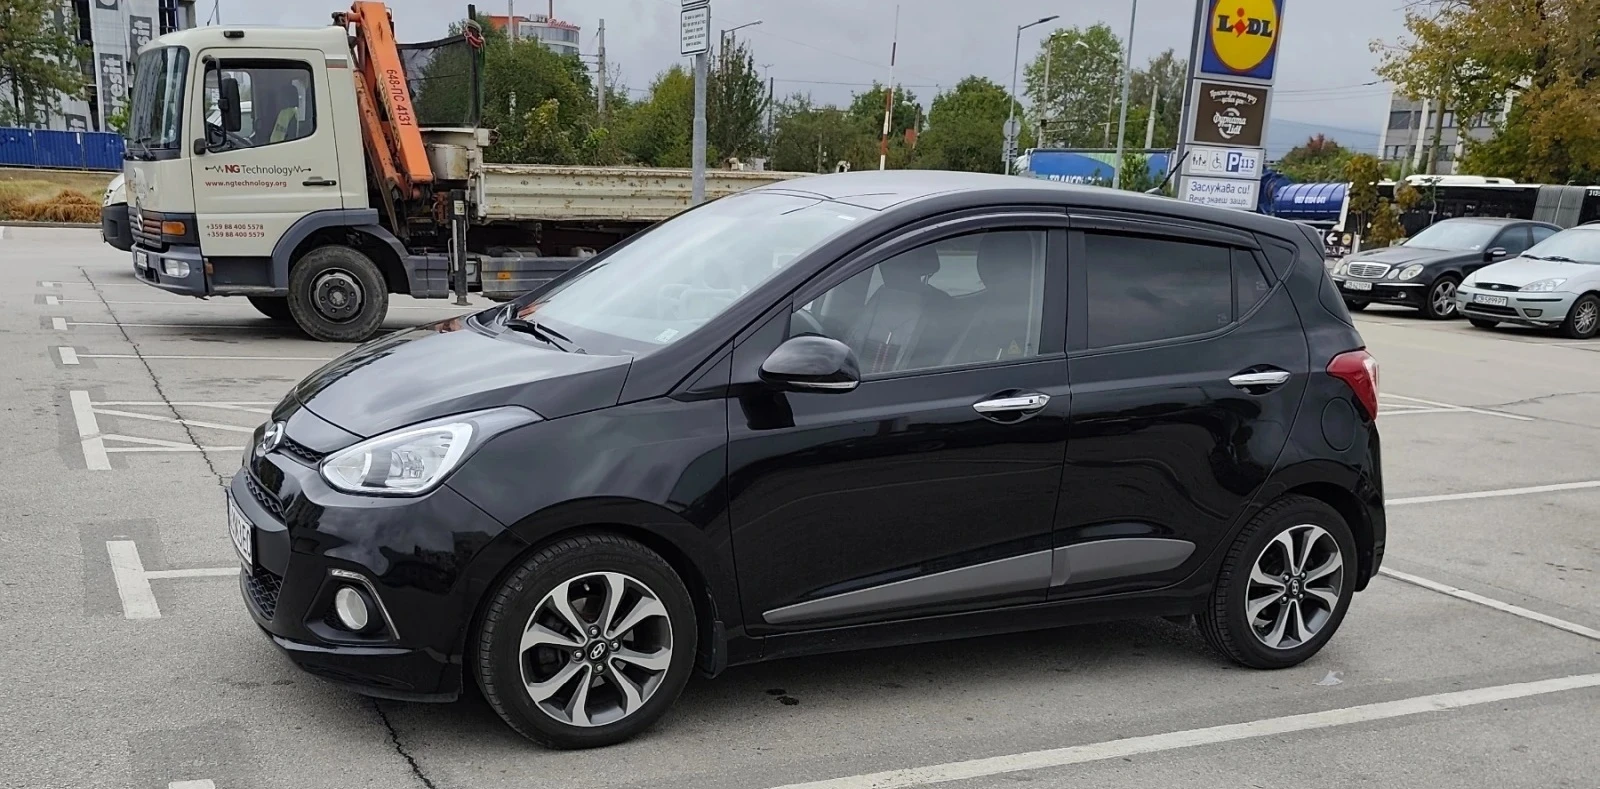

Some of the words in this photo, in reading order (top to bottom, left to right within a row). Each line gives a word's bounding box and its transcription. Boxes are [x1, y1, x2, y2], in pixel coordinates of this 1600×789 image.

[395, 104, 412, 127] 4131
[224, 164, 240, 173] NG
[241, 164, 293, 176] Technology
[1241, 158, 1255, 169] 113
[1191, 181, 1235, 194] Заслужава
[1237, 184, 1251, 195] си!
